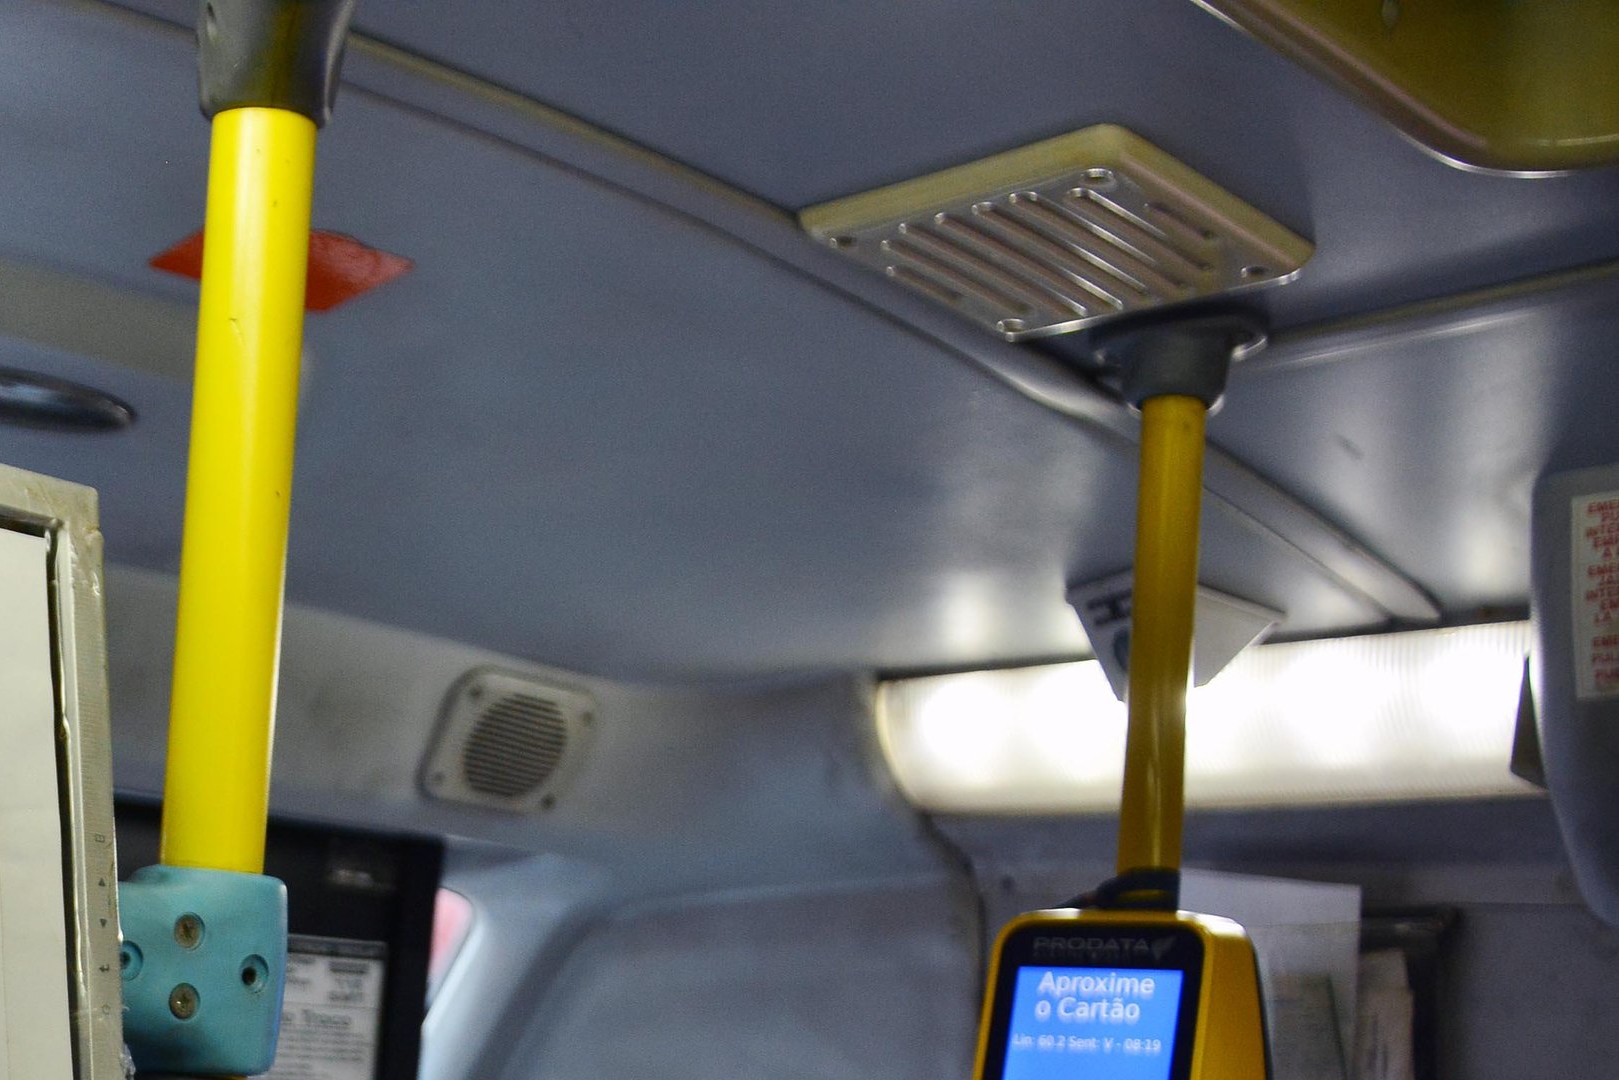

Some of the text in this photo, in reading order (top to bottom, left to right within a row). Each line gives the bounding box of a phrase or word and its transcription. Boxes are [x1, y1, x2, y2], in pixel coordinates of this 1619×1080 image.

[1033, 937, 1149, 950] PRODATA
[1038, 971, 1155, 998] Aproxime
[1035, 996, 1140, 1020] o Cartão
